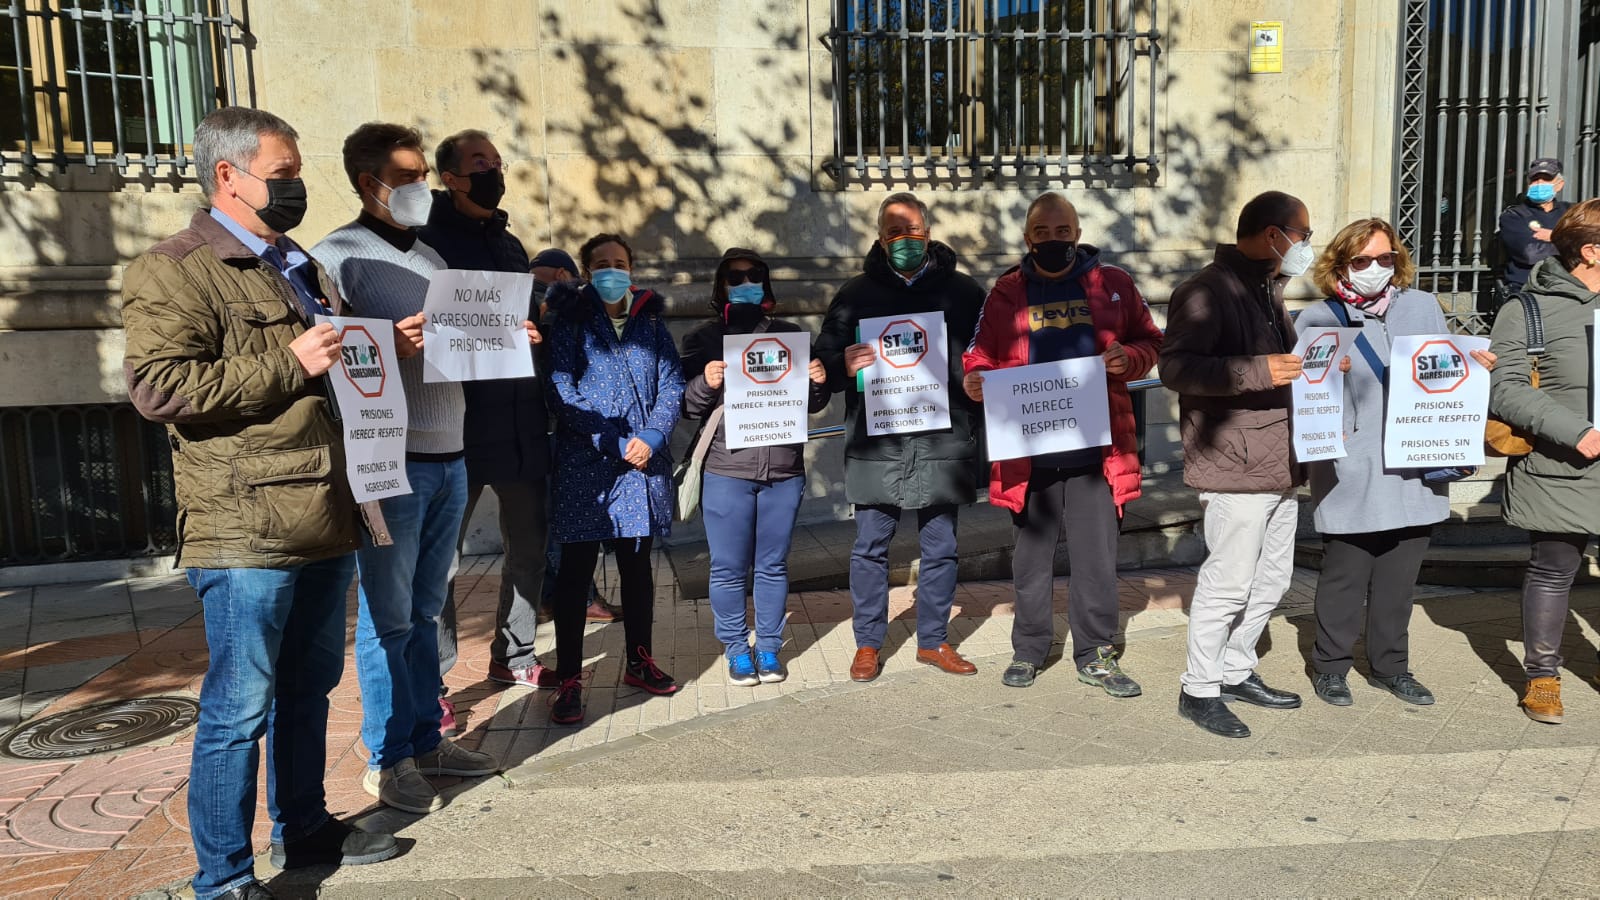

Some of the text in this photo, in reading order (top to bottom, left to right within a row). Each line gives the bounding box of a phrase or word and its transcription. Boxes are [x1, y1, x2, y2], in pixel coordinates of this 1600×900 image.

[453, 284, 502, 302] NO MÁS
[431, 313, 519, 327] AGRESIONES EN
[450, 337, 504, 352] PRISIONES
[885, 345, 924, 357] AGRESIONES
[348, 367, 383, 379] AGRESIONES
[748, 363, 787, 373] AGRESIONES
[871, 374, 915, 386] #PRISIONES
[1418, 369, 1465, 380] AGRESIONES
[872, 383, 940, 397] MERECE RESPETO
[1012, 376, 1079, 395] PRISIONES
[746, 388, 788, 398] PRISIONES
[731, 399, 803, 410] MERECE RESPETO
[873, 404, 936, 417] #PRISIONES SIN
[1021, 397, 1074, 415] MERECE
[1317, 405, 1340, 414] RESPETO
[1414, 401, 1464, 410] PRISIONES
[360, 408, 394, 420] PRISIONES
[1395, 413, 1481, 424] MERECE RESPETO
[738, 419, 796, 430] PRISIONES SIN
[874, 418, 924, 430] AGRESIONES
[1021, 417, 1077, 435] RESPETO
[350, 427, 404, 440] MERECE RESPETO
[743, 432, 792, 442] AGRESIONES
[1302, 431, 1336, 441] PRISIONES SIN
[1401, 438, 1470, 448] PRISIONES SIN
[1306, 445, 1336, 455] AGRESIONES
[1407, 452, 1466, 462] AGRESIONES
[357, 460, 398, 474] PRISIONES SIN
[365, 479, 400, 493] AGRESIONES
